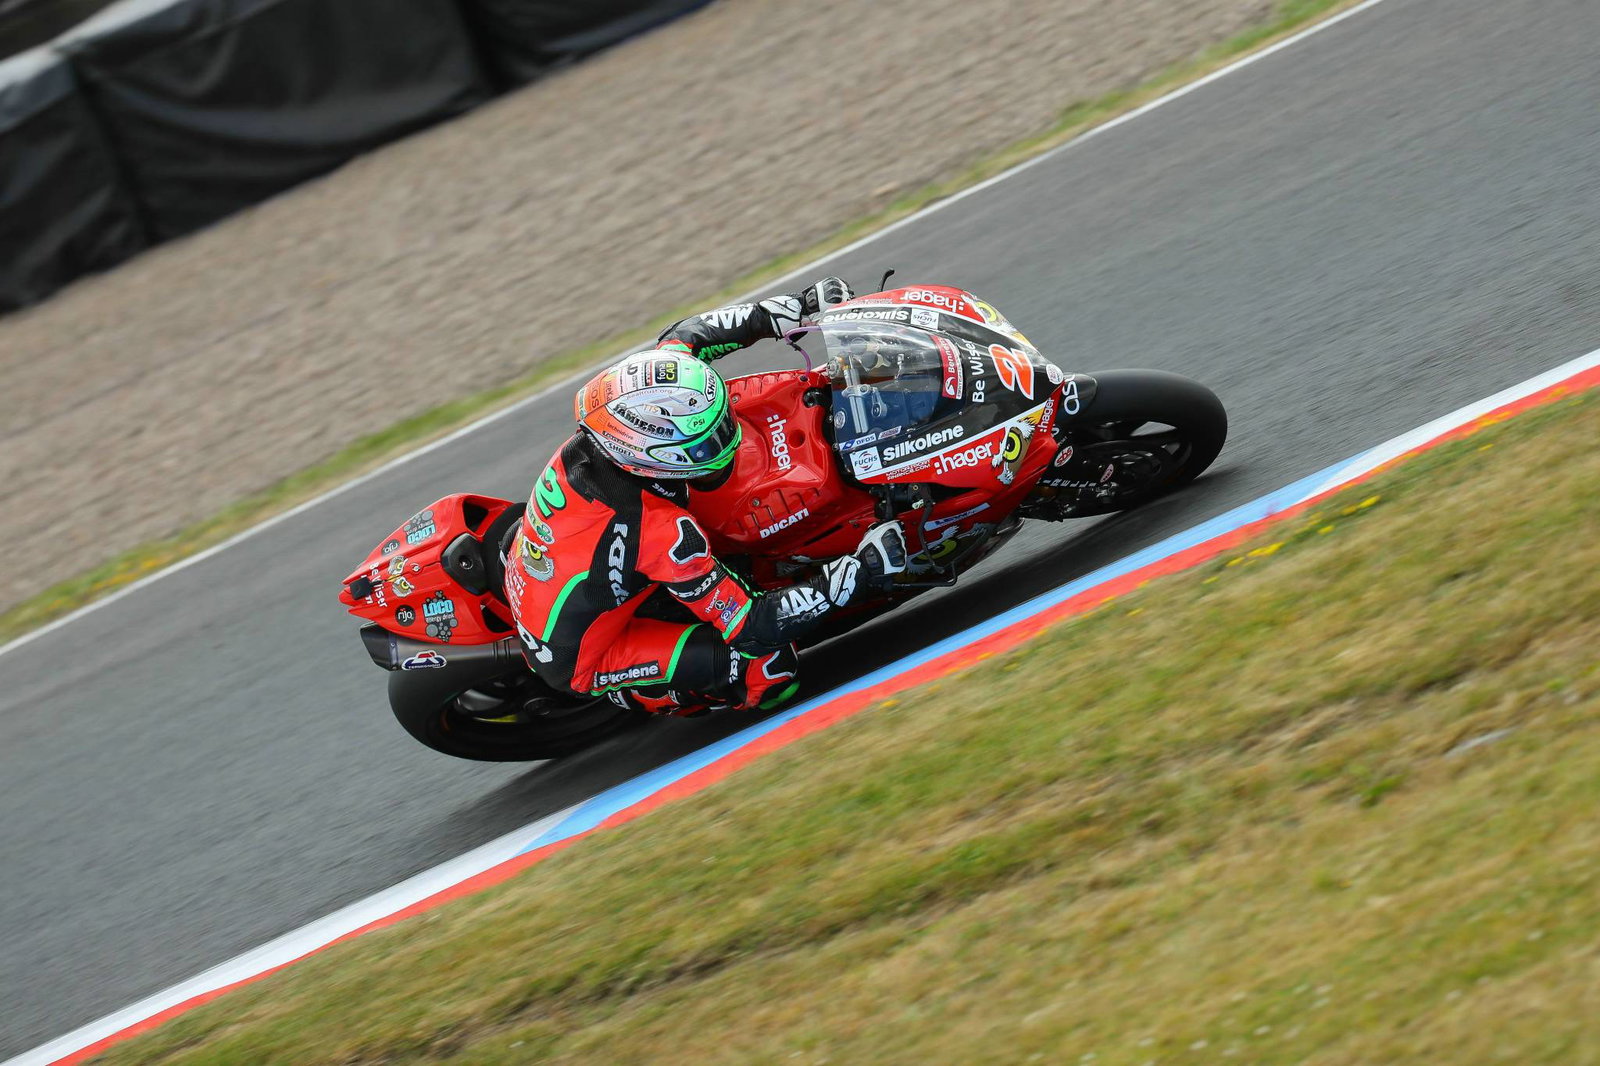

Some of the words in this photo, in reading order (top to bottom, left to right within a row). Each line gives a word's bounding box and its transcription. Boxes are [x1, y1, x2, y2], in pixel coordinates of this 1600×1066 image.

[965, 339, 982, 375] Wiser
[657, 363, 666, 380] fona
[666, 362, 675, 381] CAB
[988, 343, 1034, 400] 2
[971, 380, 985, 403] Be
[613, 403, 675, 438] JAMIESON
[693, 418, 705, 428] PSI
[608, 442, 631, 456] SHOEI
[883, 424, 964, 462] Silkolene
[854, 454, 878, 466] FUCHS
[535, 466, 566, 518] 2
[759, 508, 809, 538] DUCATI
[369, 562, 380, 576] Be
[422, 600, 454, 617] LOCO
